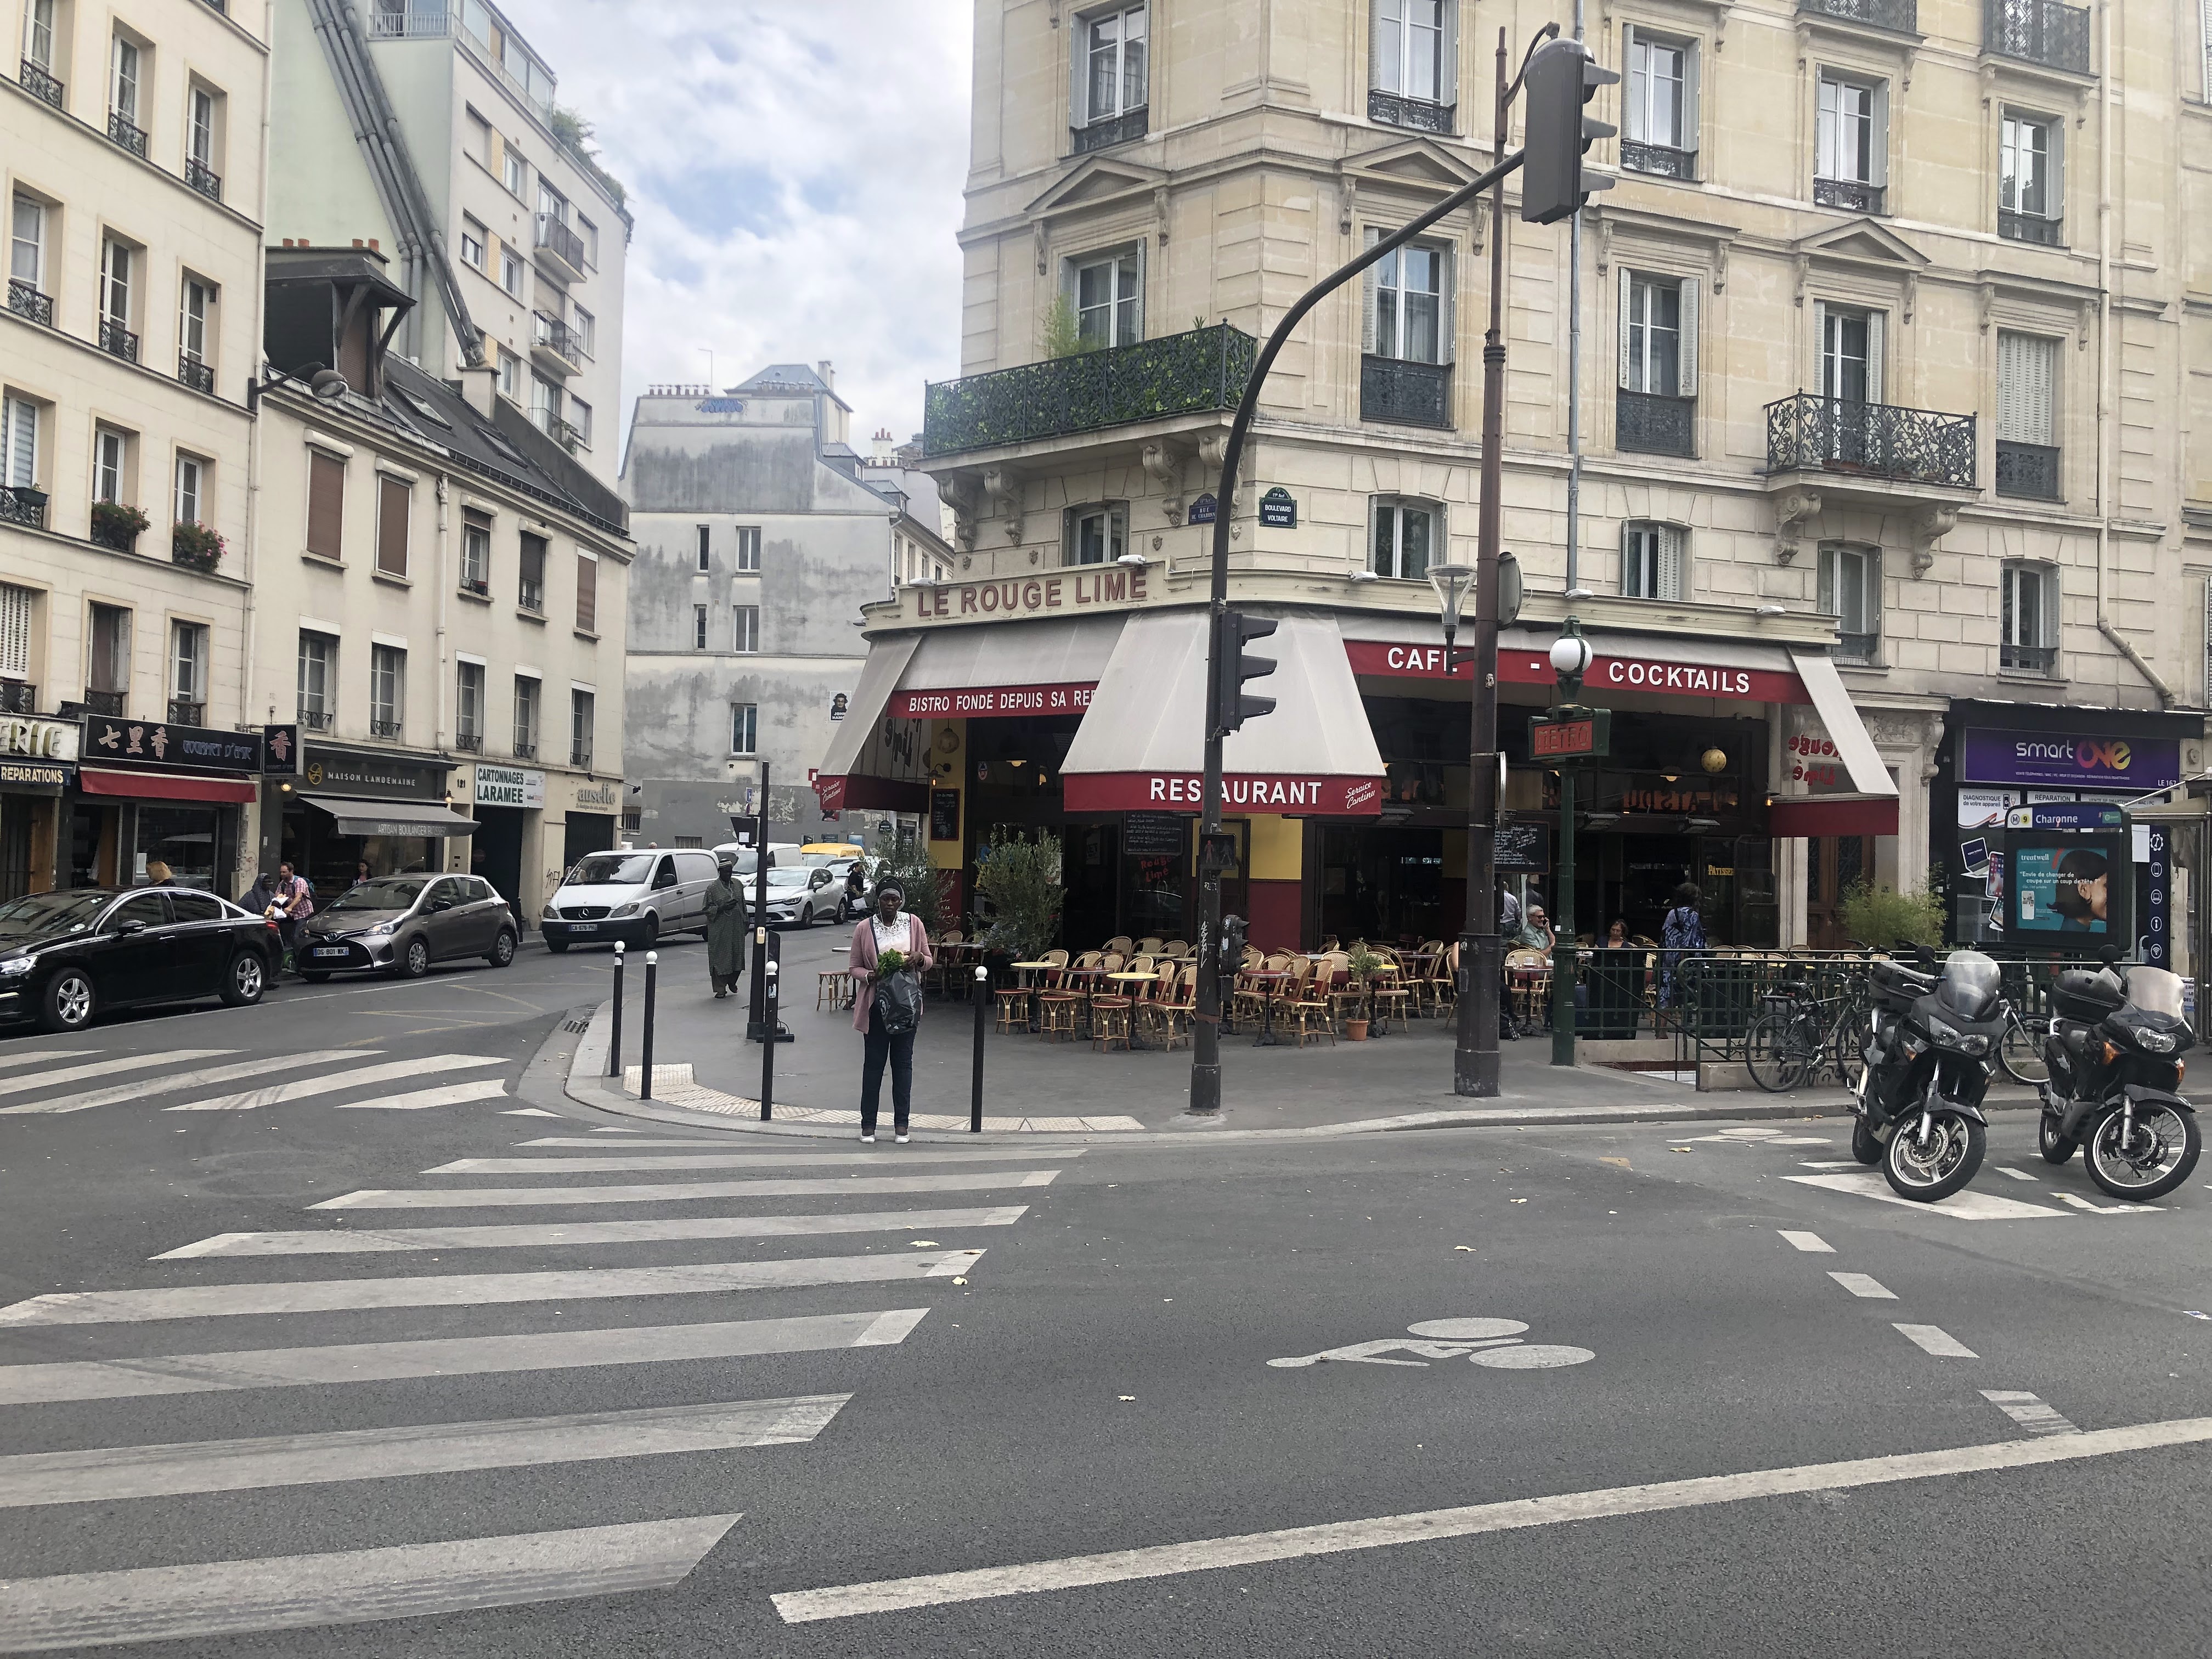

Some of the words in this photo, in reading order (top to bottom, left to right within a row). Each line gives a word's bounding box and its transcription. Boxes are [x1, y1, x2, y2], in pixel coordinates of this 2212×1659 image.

[1265, 504, 1291, 512] BOULEVARD
[1267, 514, 1288, 522] VOLTAIRE
[918, 589, 949, 617] LE
[961, 579, 1062, 613] ROUGE
[1609, 662, 1750, 693] COCKTAILS
[909, 696, 950, 712] BISTRO
[956, 691, 994, 710] FONDÉ
[1000, 692, 1043, 709] DEPUIS
[1050, 691, 1066, 707] SA
[98, 724, 169, 760] 七里香
[269, 730, 291, 761] 香
[1538, 725, 1589, 751] METRO
[2016, 740, 2074, 759] smart
[328, 771, 361, 781] MAISON
[364, 775, 416, 786] LANDEMAINE
[477, 768, 524, 785] CARTONNAGES
[477, 785, 523, 804] LARAMEE
[1150, 778, 1322, 804] RESAURANT
[1345, 781, 1372, 799] Service
[1346, 789, 1375, 809] Continu
[2035, 815, 2078, 823] Charonne
[378, 825, 398, 834] ARTISAN
[399, 825, 427, 835] BOULANGER
